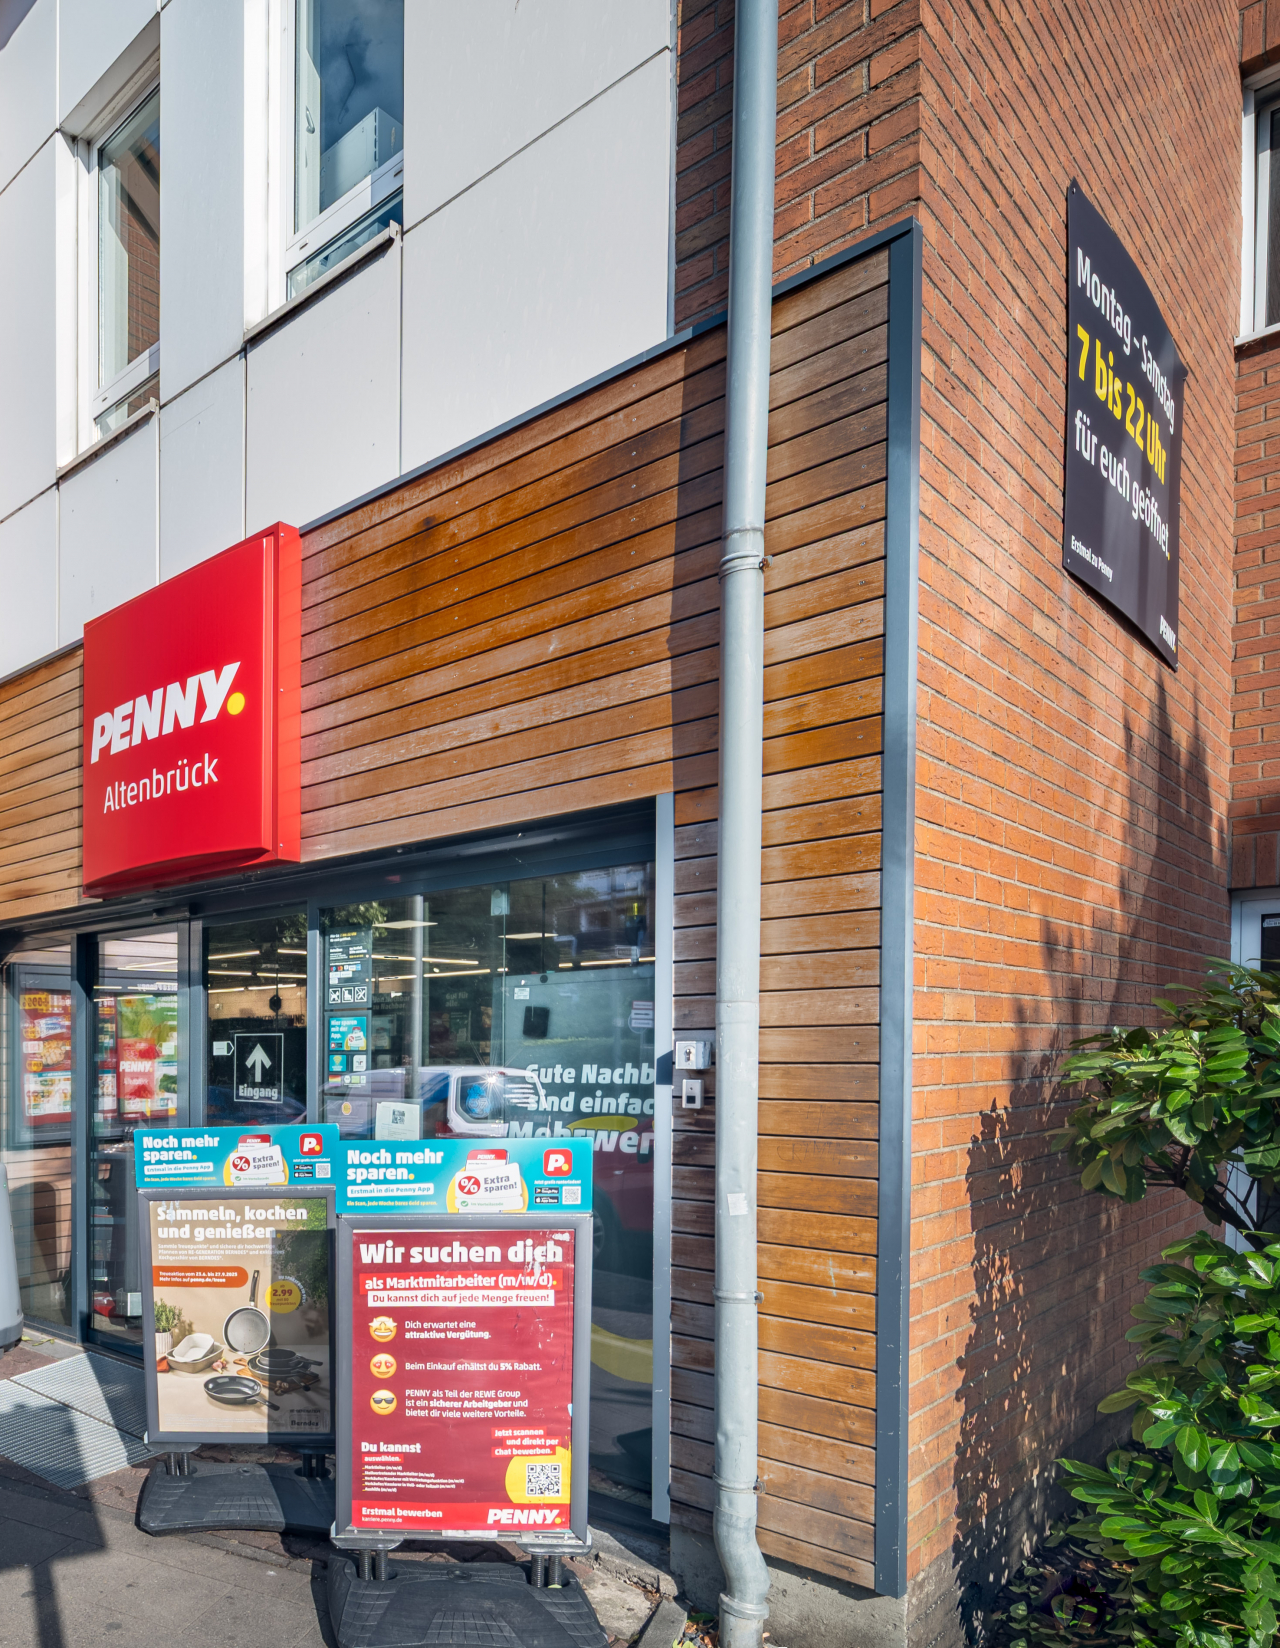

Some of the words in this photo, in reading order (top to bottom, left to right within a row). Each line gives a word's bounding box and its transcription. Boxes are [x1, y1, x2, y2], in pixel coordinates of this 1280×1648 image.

[1077, 247, 1131, 355] Montag
[1142, 335, 1175, 434] Samstag
[1077, 323, 1089, 381] 7
[1096, 338, 1122, 420] bis
[1126, 382, 1144, 452] 22
[1147, 412, 1166, 484] Uhr
[1075, 410, 1098, 466] für
[1100, 445, 1129, 502] euch
[1132, 480, 1170, 560] geöffnet.
[1071, 535, 1091, 562] Erstmal
[1092, 553, 1098, 567] zu
[1098, 557, 1113, 582] Penny
[91, 661, 245, 764] PENNY.
[104, 753, 218, 813] Altenbrück
[525, 1064, 575, 1084] Gute
[581, 1063, 654, 1084] Nachb
[239, 1084, 278, 1100] Eingang
[527, 1089, 575, 1112] sind
[580, 1090, 654, 1115] einfac
[143, 1135, 178, 1148] Noch
[182, 1134, 220, 1148] mehr
[508, 1120, 654, 1154] Mehwer
[143, 1150, 197, 1163] sparen.
[252, 1155, 274, 1163] Extra
[347, 1149, 391, 1164] Noch
[396, 1148, 444, 1164] mehr
[253, 1161, 280, 1169] sparen!
[347, 1168, 415, 1183] sparen.
[484, 1175, 510, 1185] Extra
[484, 1182, 517, 1193] sparen!
[157, 1206, 241, 1223] Sammeln,
[244, 1205, 308, 1220] kochen
[157, 1224, 190, 1239] und
[194, 1223, 282, 1242] genießen.
[360, 1240, 404, 1264] Wir
[410, 1241, 501, 1264] suchen
[508, 1239, 563, 1262] dich
[365, 1277, 383, 1289] als
[386, 1274, 496, 1289] Marktmitarbeiter
[498, 1273, 557, 1288] (m/w/d).
[372, 1295, 385, 1303] Du
[387, 1294, 418, 1302] kannst
[421, 1294, 439, 1302] dich
[442, 1294, 457, 1302] auf
[458, 1294, 479, 1303] jede
[482, 1294, 513, 1303] Menge
[515, 1294, 549, 1302] freuen!
[405, 1331, 445, 1339] attraktive
[446, 1331, 491, 1340] Vergütung.
[427, 1363, 456, 1371] Einkauf
[457, 1362, 487, 1371] erhältst
[500, 1363, 512, 1371] 5%
[514, 1363, 542, 1371] Rabatt.
[445, 1390, 458, 1398] Teil
[460, 1390, 473, 1398] der
[474, 1390, 496, 1398] REWE
[497, 1390, 520, 1398] Group
[405, 1399, 414, 1407] ist
[416, 1399, 428, 1407] ein
[430, 1399, 462, 1407] sicherer
[463, 1400, 512, 1408] Arbeitgeber
[513, 1399, 528, 1407] und
[430, 1409, 440, 1417] dir
[361, 1442, 377, 1452] Du
[380, 1442, 421, 1453] kannst
[362, 1507, 395, 1516] Erstmal
[397, 1508, 443, 1517] bewerben
[487, 1509, 561, 1524] PENNY.
